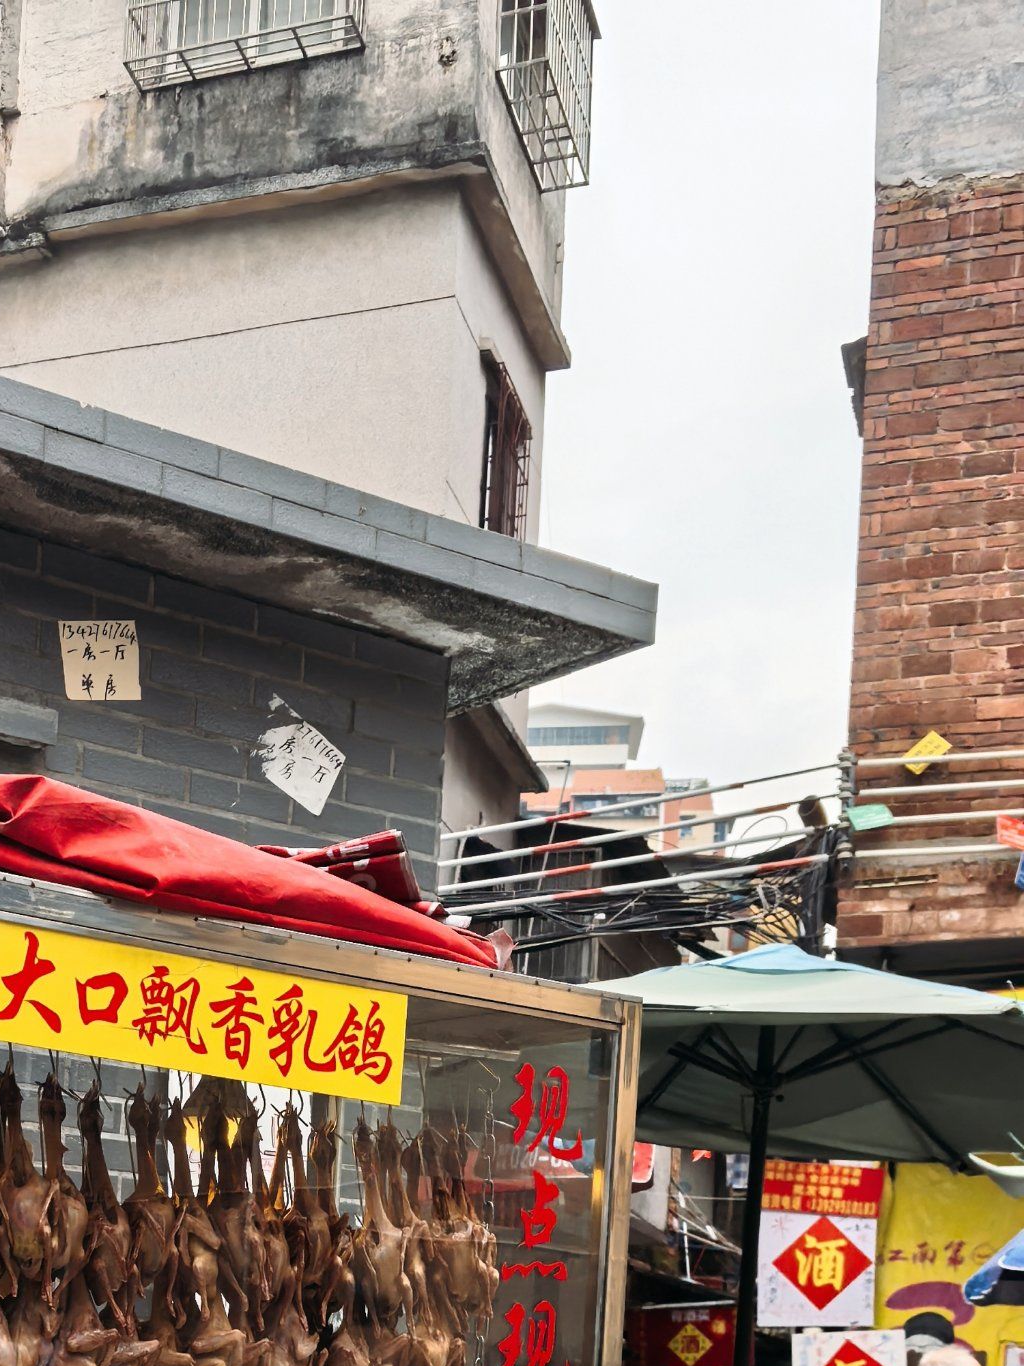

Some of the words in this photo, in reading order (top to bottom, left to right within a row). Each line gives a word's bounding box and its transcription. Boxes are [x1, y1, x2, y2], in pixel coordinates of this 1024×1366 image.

[67, 642, 127, 660] 一房一厅
[793, 1232, 849, 1292] 酒
